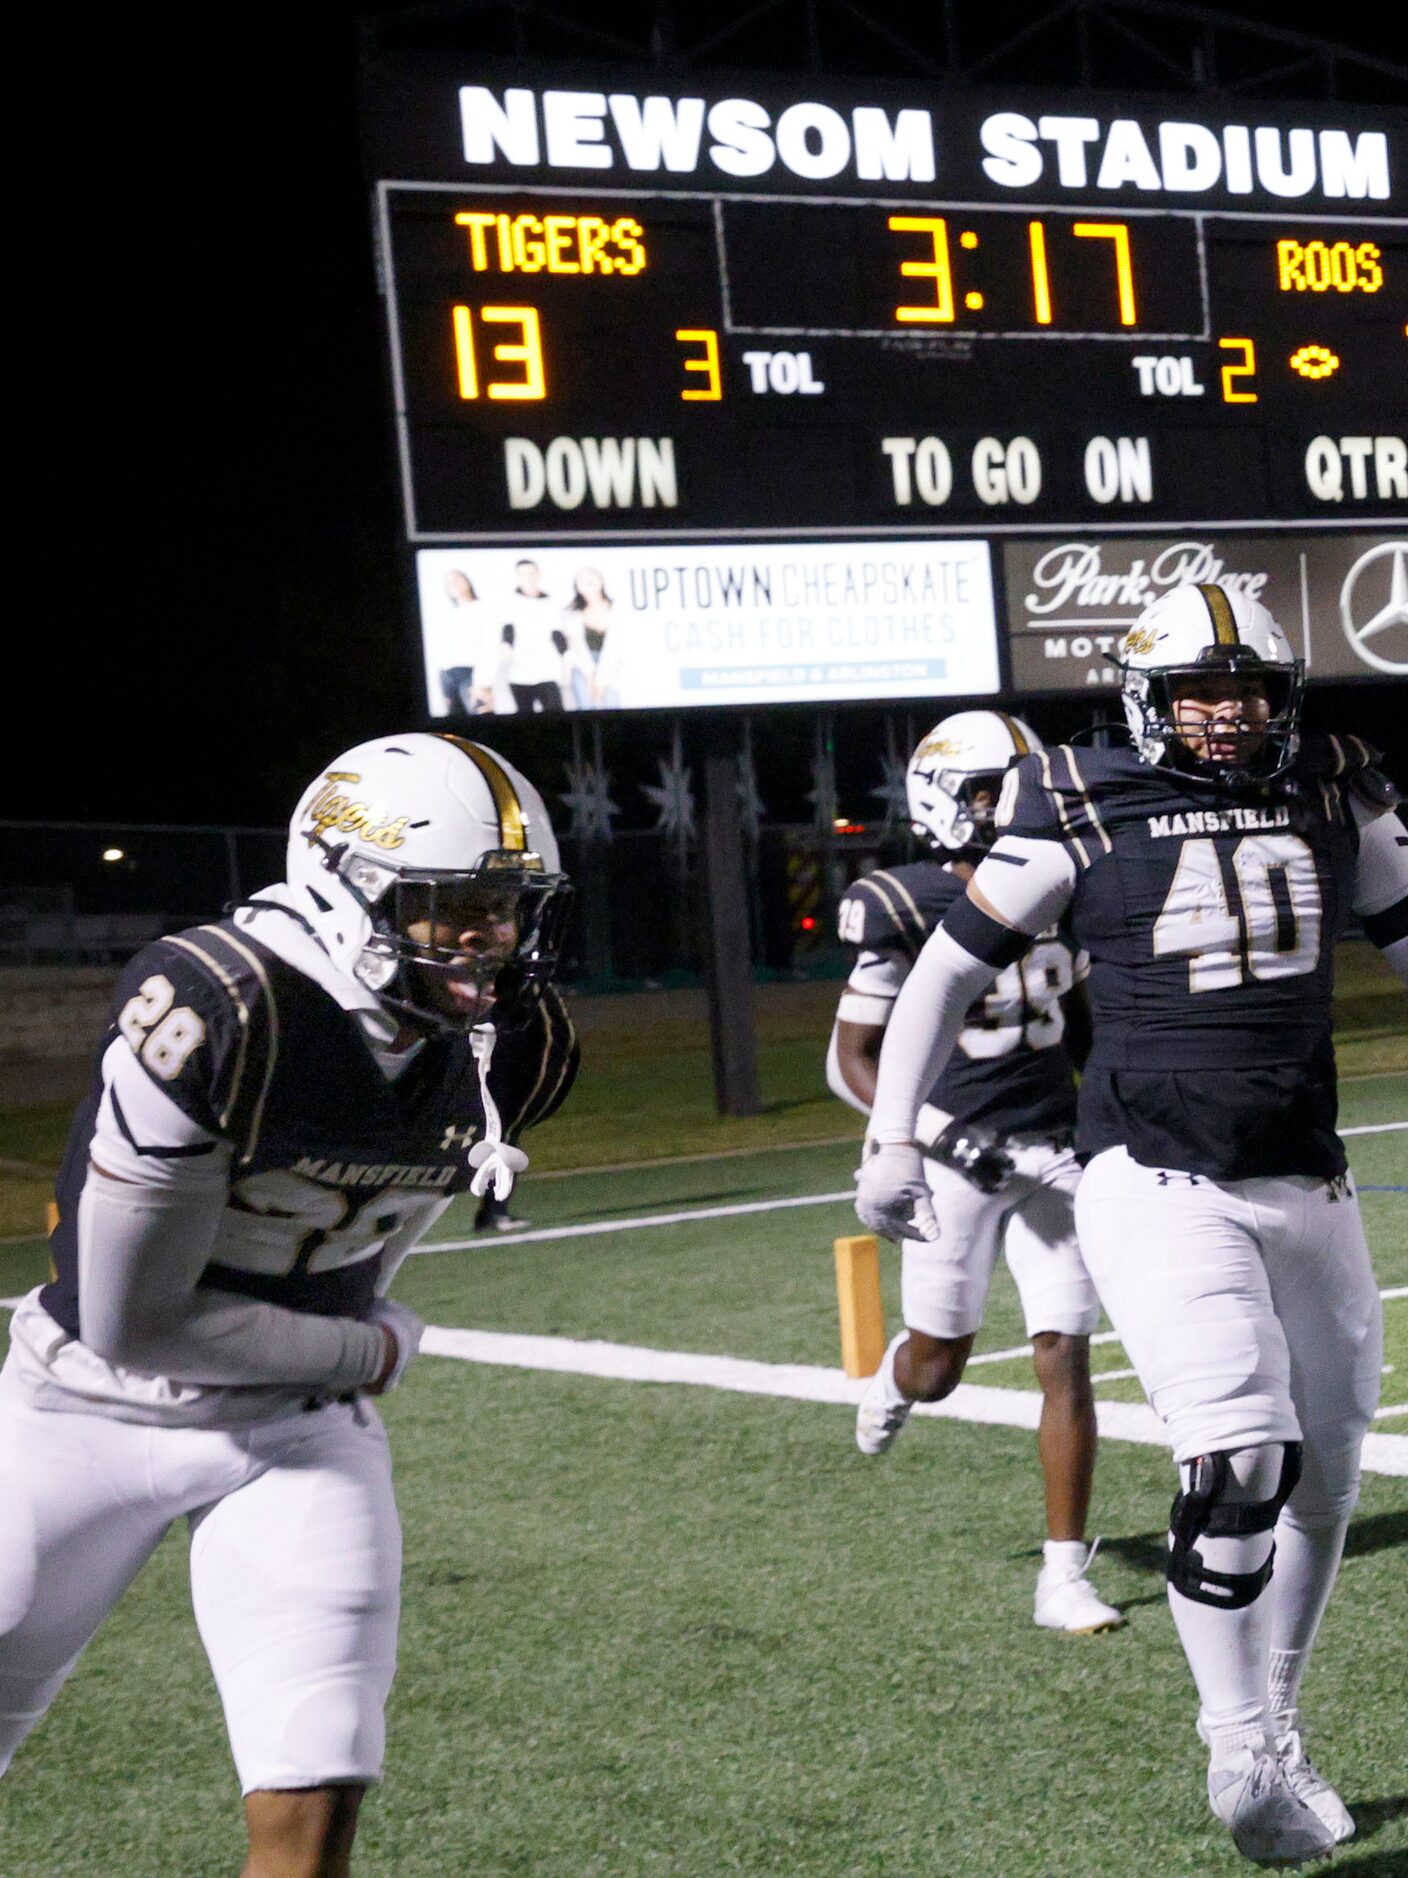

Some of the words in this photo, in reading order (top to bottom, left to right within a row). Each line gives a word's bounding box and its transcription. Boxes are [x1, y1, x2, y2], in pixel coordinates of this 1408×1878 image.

[457, 86, 937, 182] NEWSOM
[980, 112, 1391, 200] STADIUM
[454, 211, 647, 276] TIGERS
[888, 215, 1136, 326] 3:17
[1276, 239, 1383, 293] ROOS
[451, 305, 547, 401] 13
[676, 329, 724, 401] 3
[743, 351, 824, 394] TOL
[1132, 356, 1204, 396] TOL
[1219, 338, 1258, 403] 2
[504, 437, 678, 509] DOWN
[881, 437, 952, 507] TO
[971, 437, 1042, 505] GO
[1084, 436, 1153, 503] ON
[629, 566, 774, 611] UPTOWN
[782, 560, 971, 608] CHEAPSKATE
[1026, 543, 1156, 614] Park
[663, 617, 745, 653] CASH
[758, 615, 815, 650] FOR
[825, 612, 957, 649] CLOTHES
[1147, 805, 1291, 839] MANSFIELD
[1152, 834, 1323, 994] 40
[118, 974, 206, 1081] 28
[291, 1156, 458, 1187] MANSFIELD
